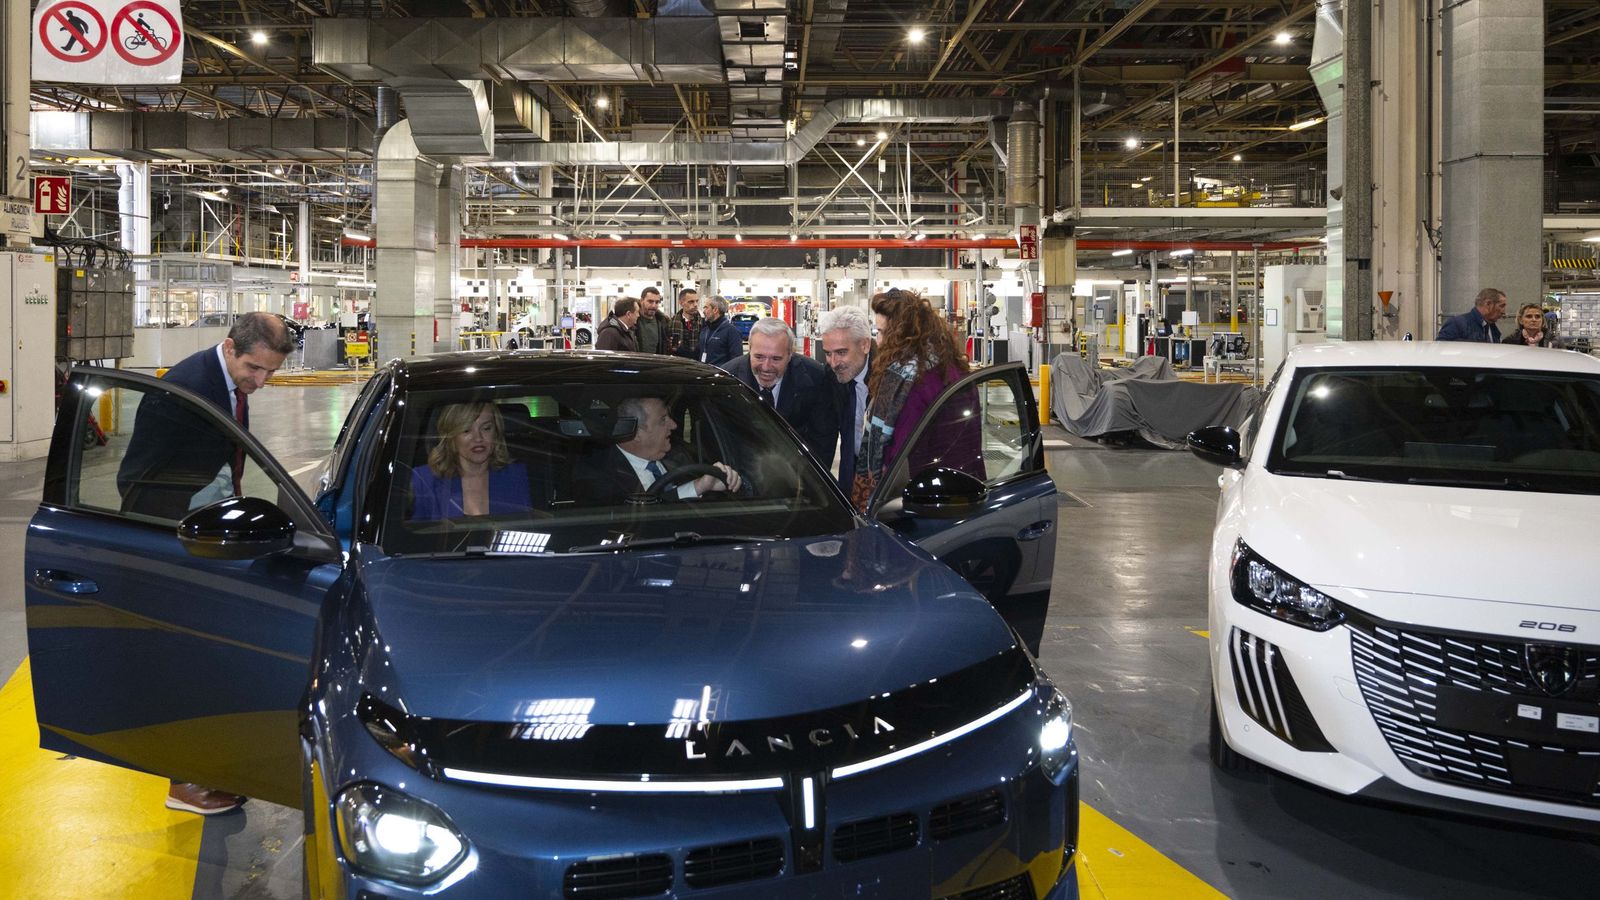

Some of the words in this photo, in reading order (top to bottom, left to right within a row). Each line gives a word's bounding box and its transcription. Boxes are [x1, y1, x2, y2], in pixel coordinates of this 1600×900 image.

[16, 156, 25, 180] 2
[1519, 620, 1577, 633] 208
[685, 716, 895, 759] LANCIA
